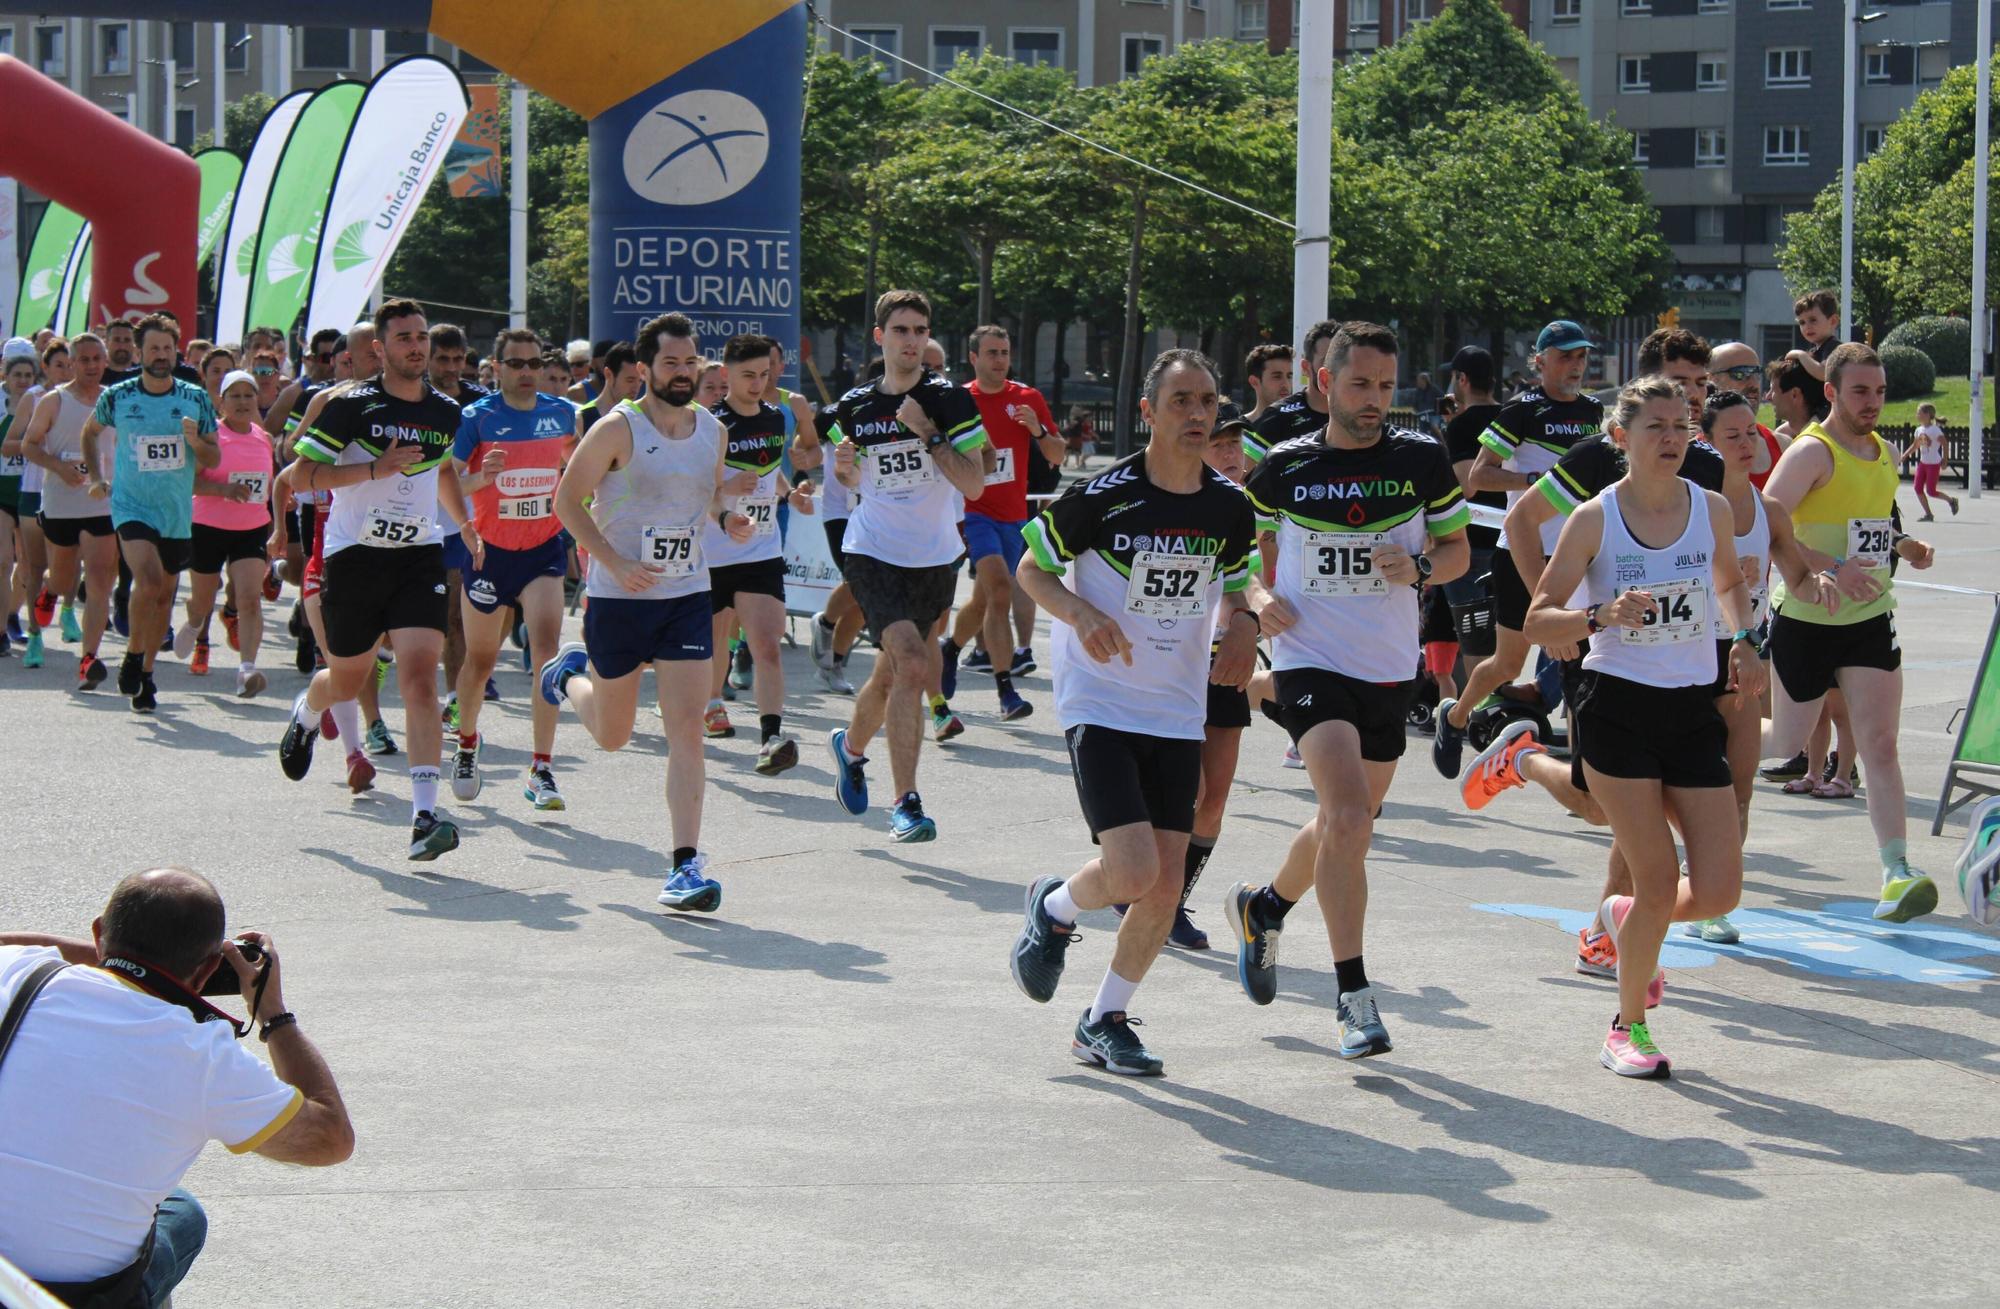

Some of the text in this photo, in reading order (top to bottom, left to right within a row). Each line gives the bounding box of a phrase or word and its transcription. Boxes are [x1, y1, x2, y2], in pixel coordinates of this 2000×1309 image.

[375, 111, 448, 232] Unicaja Banco
[614, 237, 790, 270] DEPORTE
[612, 274, 792, 308] ASTURIANO
[738, 320, 766, 337] DEL
[147, 443, 178, 460] 631
[878, 450, 923, 476] 535
[1293, 480, 1416, 503] DONAVIDA
[516, 500, 538, 517] 160
[371, 518, 419, 544] 352
[1154, 527, 1206, 536] CARRERA
[1857, 530, 1890, 553] 238
[653, 538, 691, 560] 579
[1615, 554, 1645, 563] bathco
[1318, 547, 1372, 576] 315
[1143, 568, 1200, 598] 532
[1615, 569, 1646, 581] TEAM
[104, 957, 147, 978] Canon
